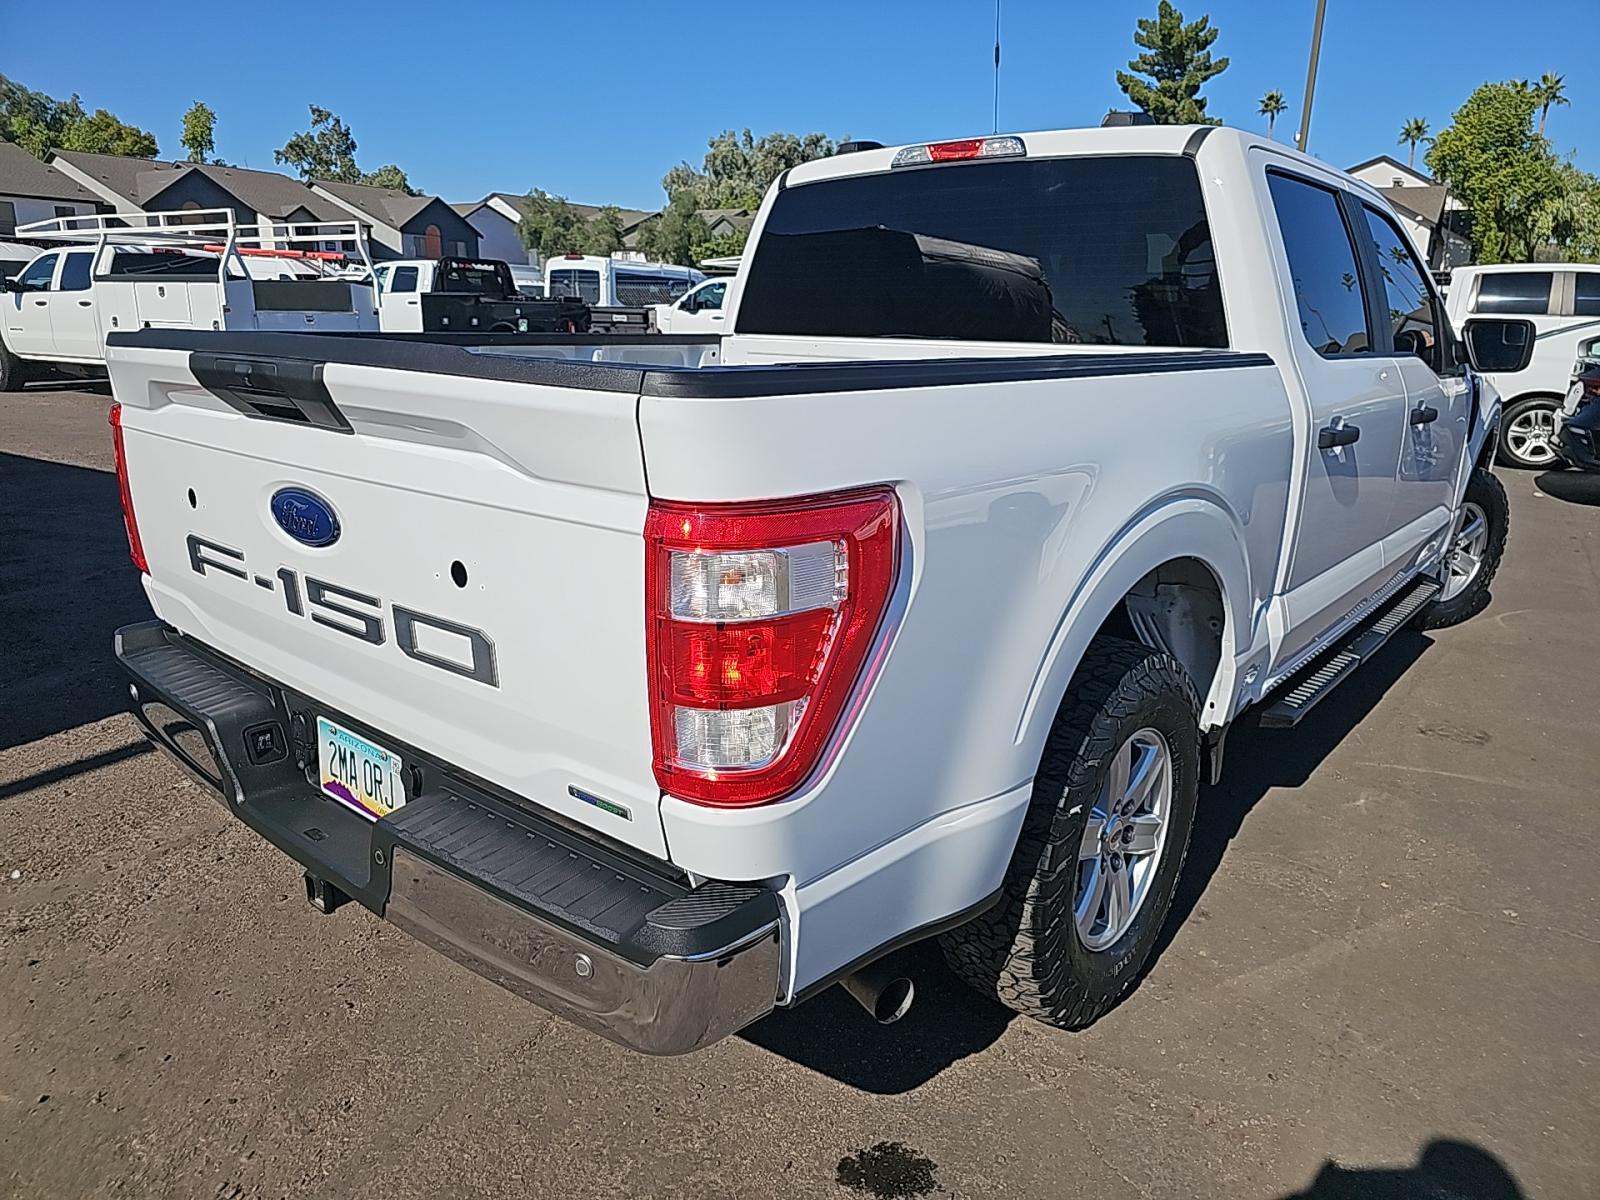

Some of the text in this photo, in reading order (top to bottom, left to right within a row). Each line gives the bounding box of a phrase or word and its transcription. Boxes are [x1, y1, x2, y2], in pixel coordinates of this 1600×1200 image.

[281, 499, 320, 538] Ford
[186, 533, 501, 689] F-150
[329, 741, 358, 790] 2MA
